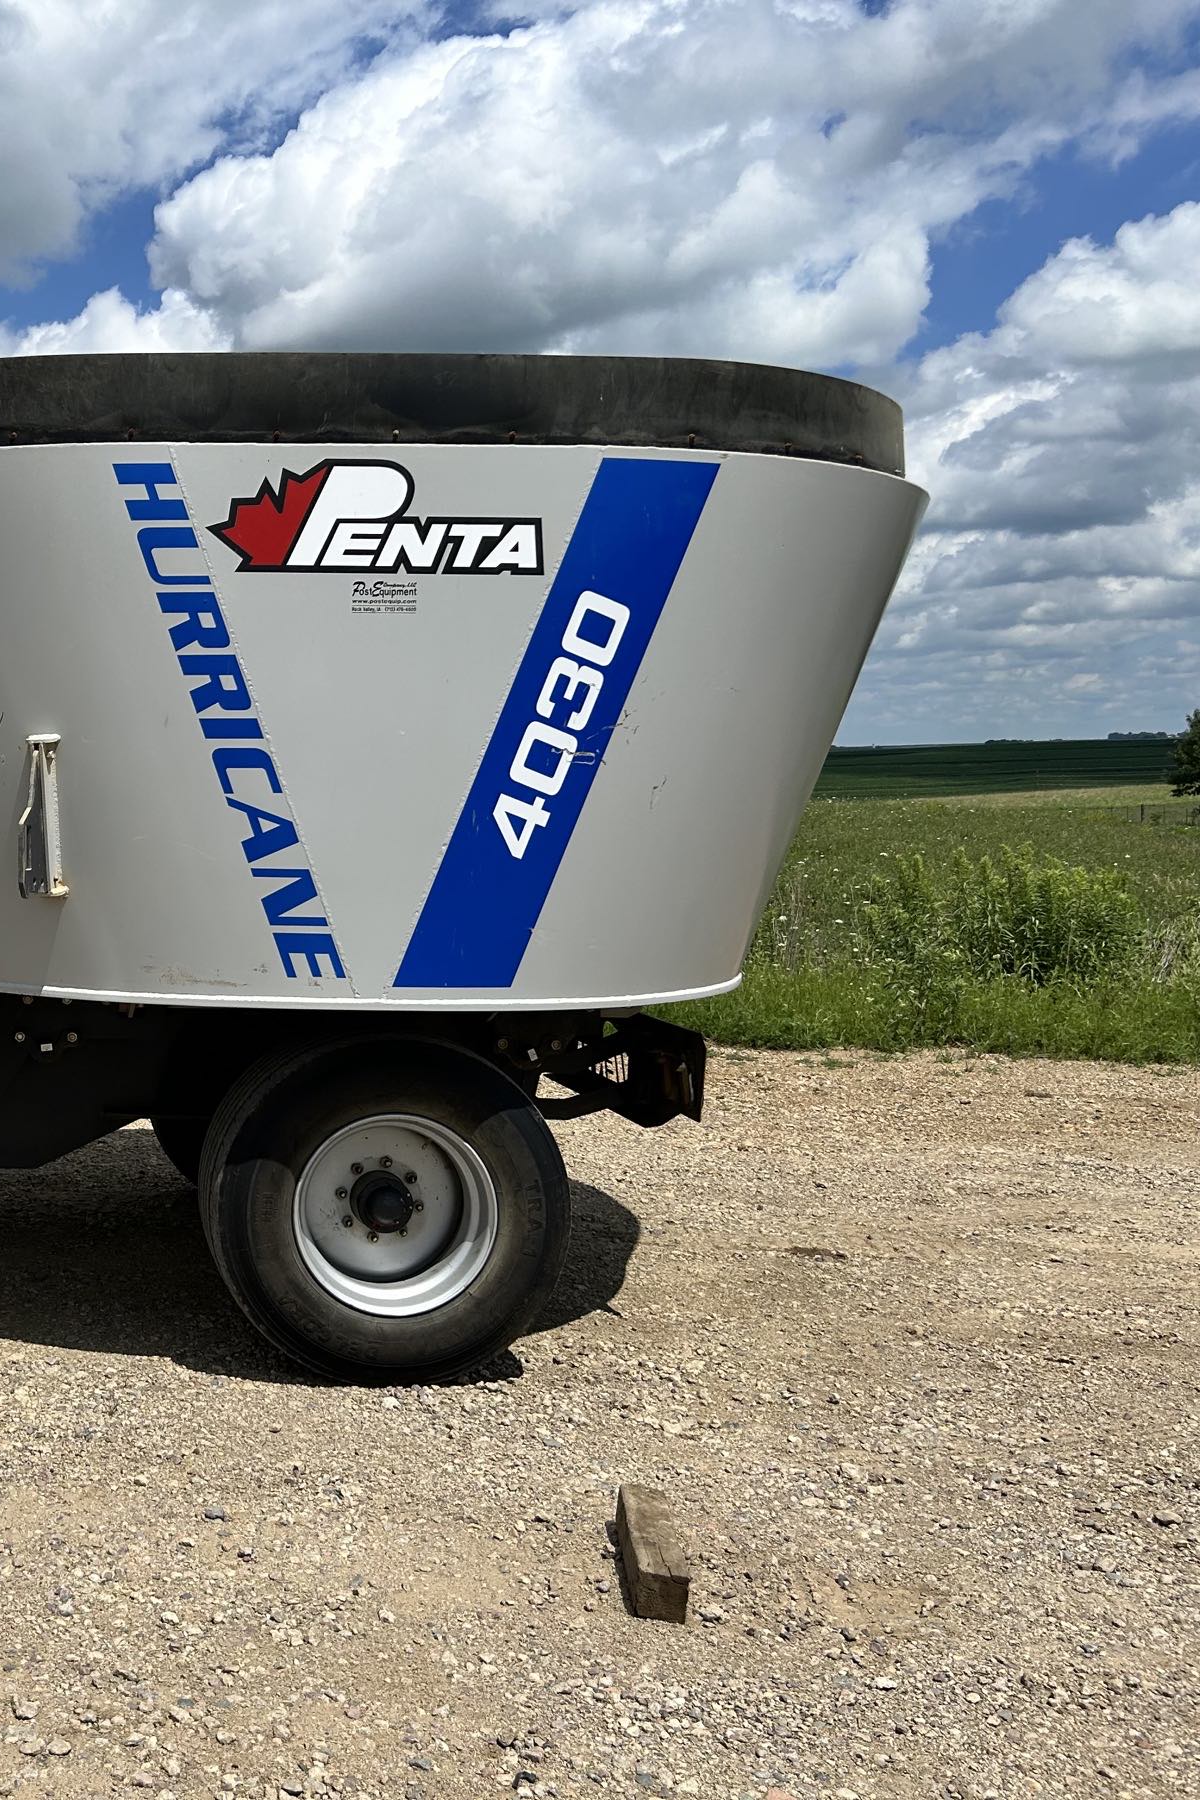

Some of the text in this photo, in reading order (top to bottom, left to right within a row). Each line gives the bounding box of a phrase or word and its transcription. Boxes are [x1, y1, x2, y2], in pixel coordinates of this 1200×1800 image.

[285, 464, 539, 570] PENTA
[112, 463, 346, 978] HURRICANE
[493, 590, 631, 859] 4030
